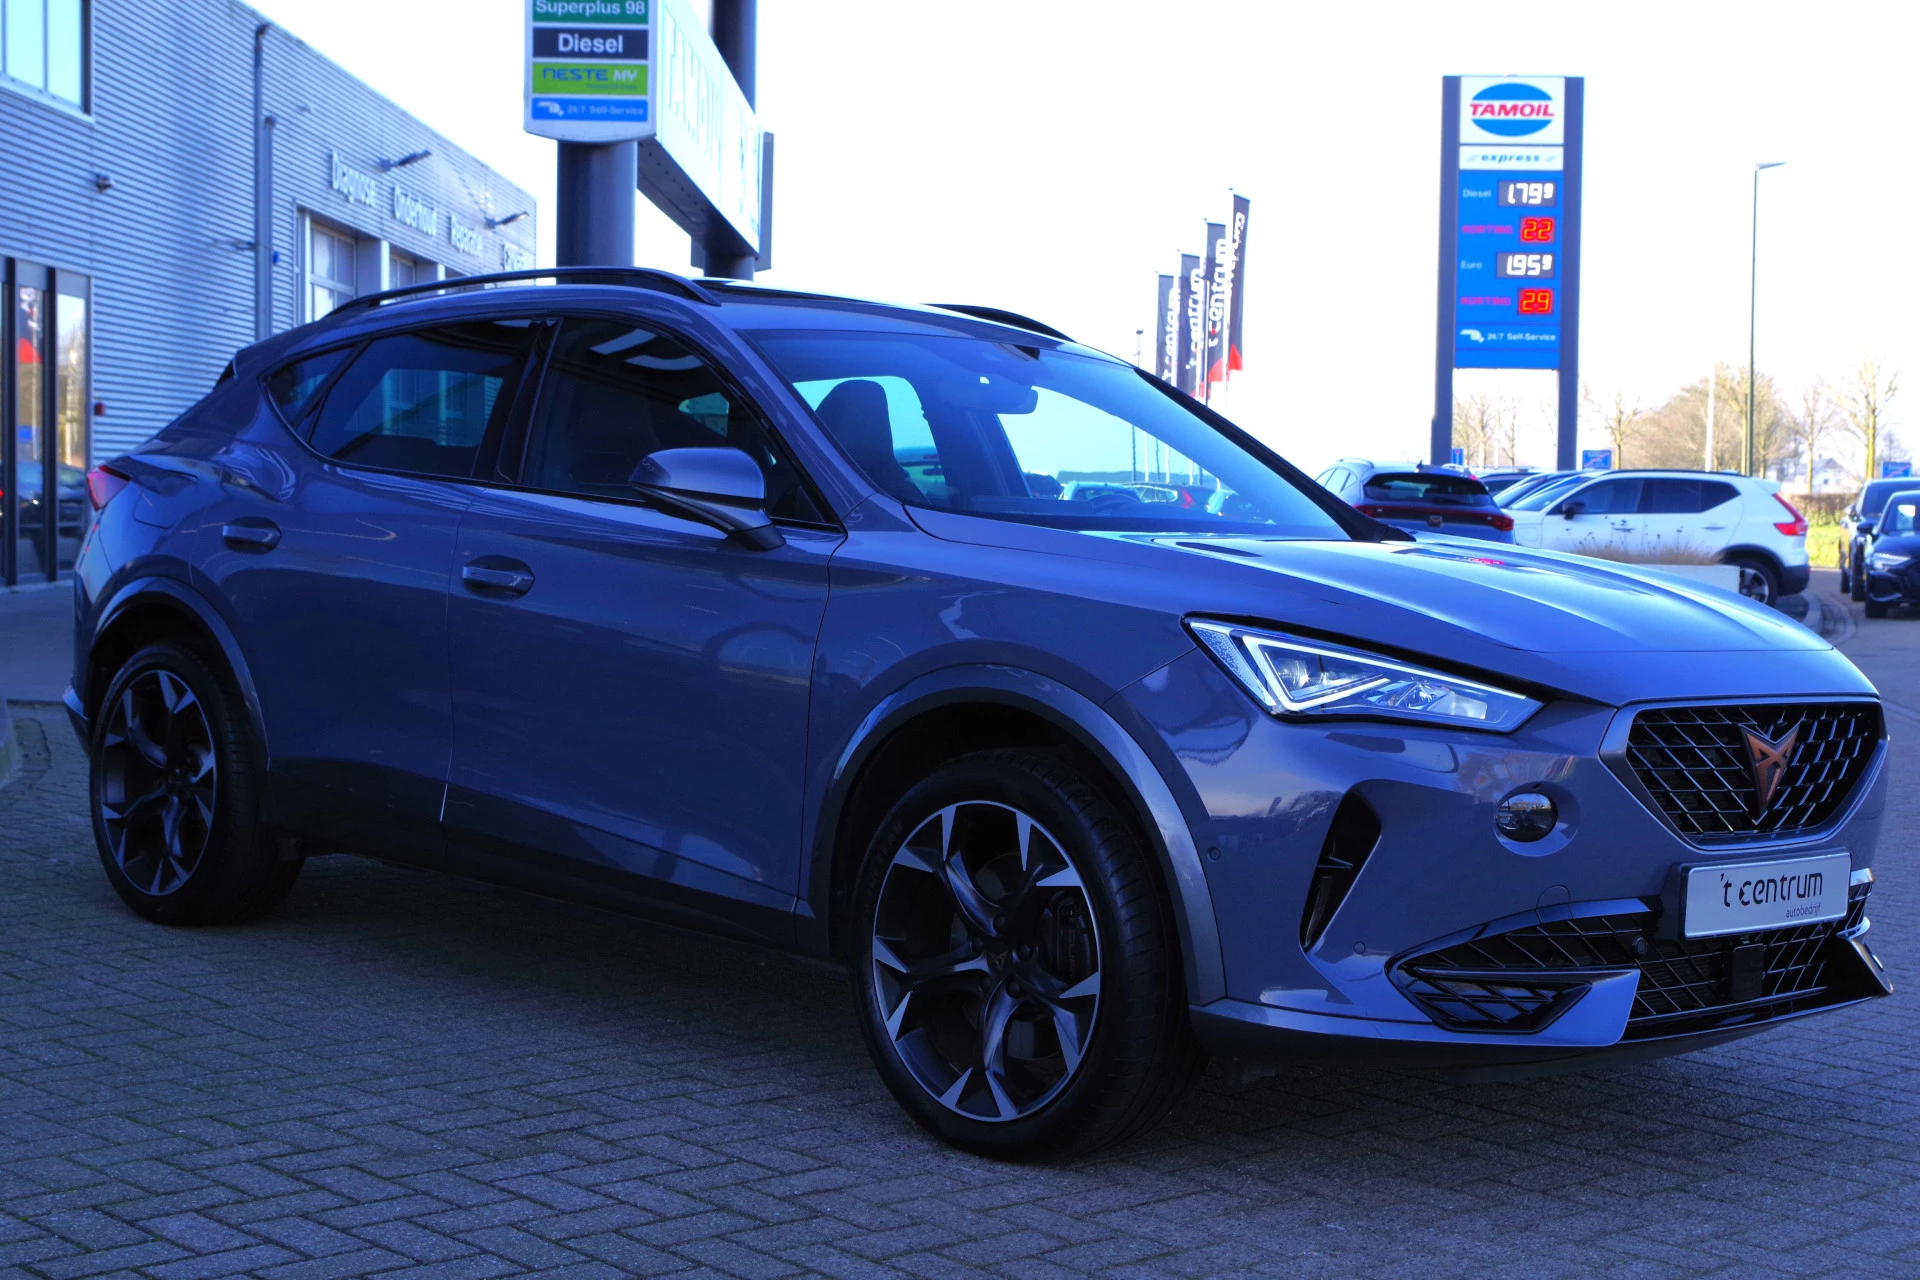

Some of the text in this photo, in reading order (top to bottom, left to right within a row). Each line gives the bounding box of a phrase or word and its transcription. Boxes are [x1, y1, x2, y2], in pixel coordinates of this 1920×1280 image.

[536, 0, 646, 17] Superplus 98
[558, 33, 623, 53] Diesel
[613, 69, 639, 82] MY
[589, 105, 644, 116] Self-Service
[1470, 103, 1555, 117] TAMOIL
[1481, 153, 1541, 163] express
[1462, 188, 1492, 198] Diesel
[1521, 217, 1553, 241] 22
[1460, 260, 1483, 270] Euro
[1518, 288, 1552, 314] 29
[1487, 332, 1556, 341] 24/7 Self-Service
[1739, 872, 1823, 906] centrum
